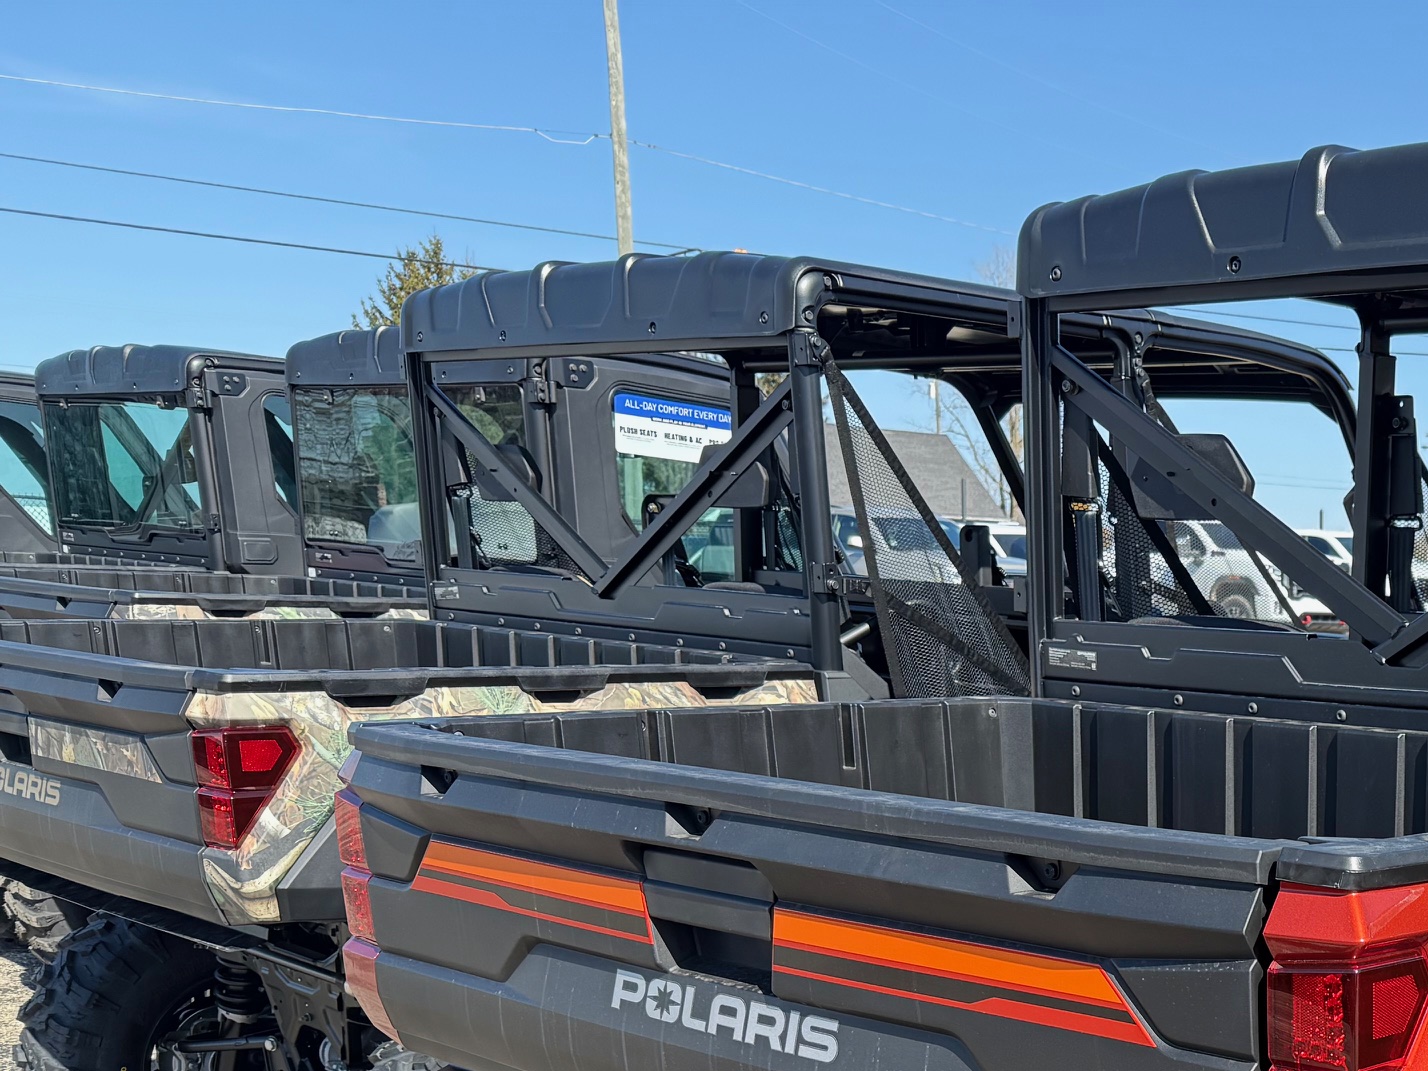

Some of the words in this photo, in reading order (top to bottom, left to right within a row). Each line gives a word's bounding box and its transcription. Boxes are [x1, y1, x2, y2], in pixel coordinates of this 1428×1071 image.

[624, 399, 657, 412] ALL-DAY
[658, 404, 694, 417] COMFORT
[694, 409, 718, 421] EVERY
[718, 414, 731, 423] DAY
[619, 425, 638, 435] PLUSH
[640, 428, 658, 438] SEATS
[664, 432, 687, 443] HEATING
[611, 968, 839, 1063] POLARIS
